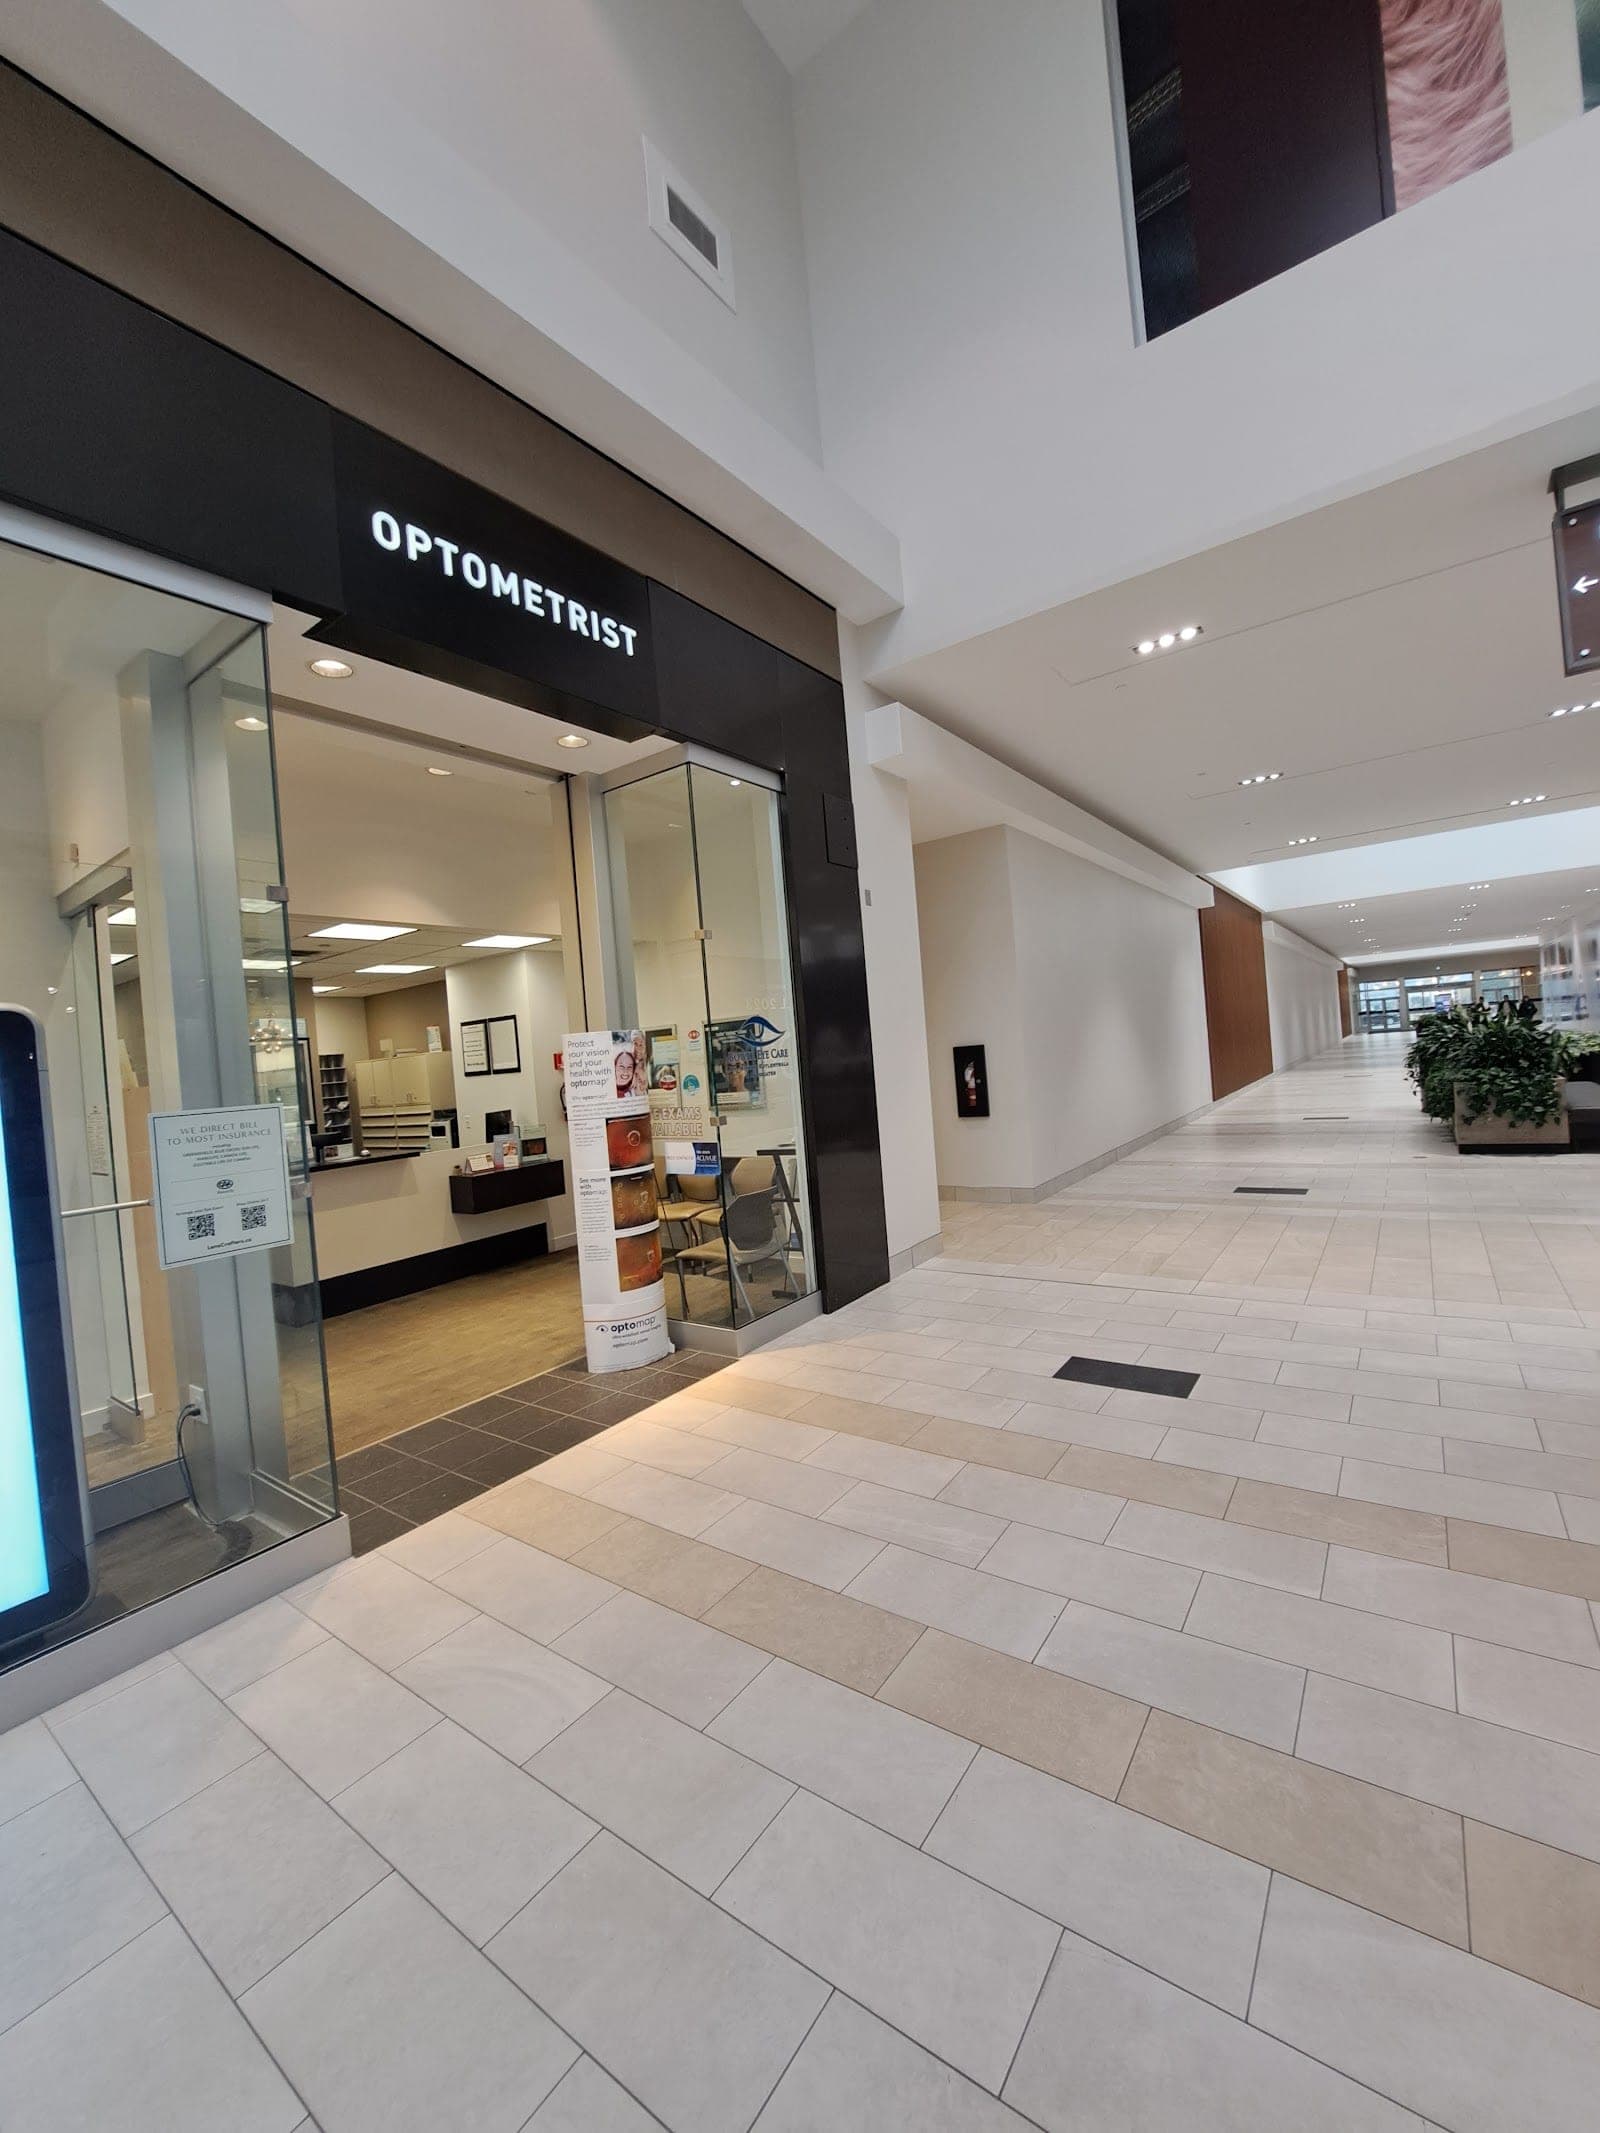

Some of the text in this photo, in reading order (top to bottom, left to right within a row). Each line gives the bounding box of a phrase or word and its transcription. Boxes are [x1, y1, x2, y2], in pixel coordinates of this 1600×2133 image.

[371, 510, 637, 657] OPTOMETRIST
[567, 1040, 594, 1049] Protect
[568, 1049, 610, 1060] your vision
[770, 1048, 788, 1059] CARE
[569, 1060, 602, 1069] and your
[569, 1067, 612, 1078] health with
[662, 1107, 702, 1121] EXAMS
[180, 1121, 258, 1136] WE DIRECT BILL
[168, 1128, 272, 1146] TO MOST INSURANCE
[610, 1316, 656, 1333] optomap
